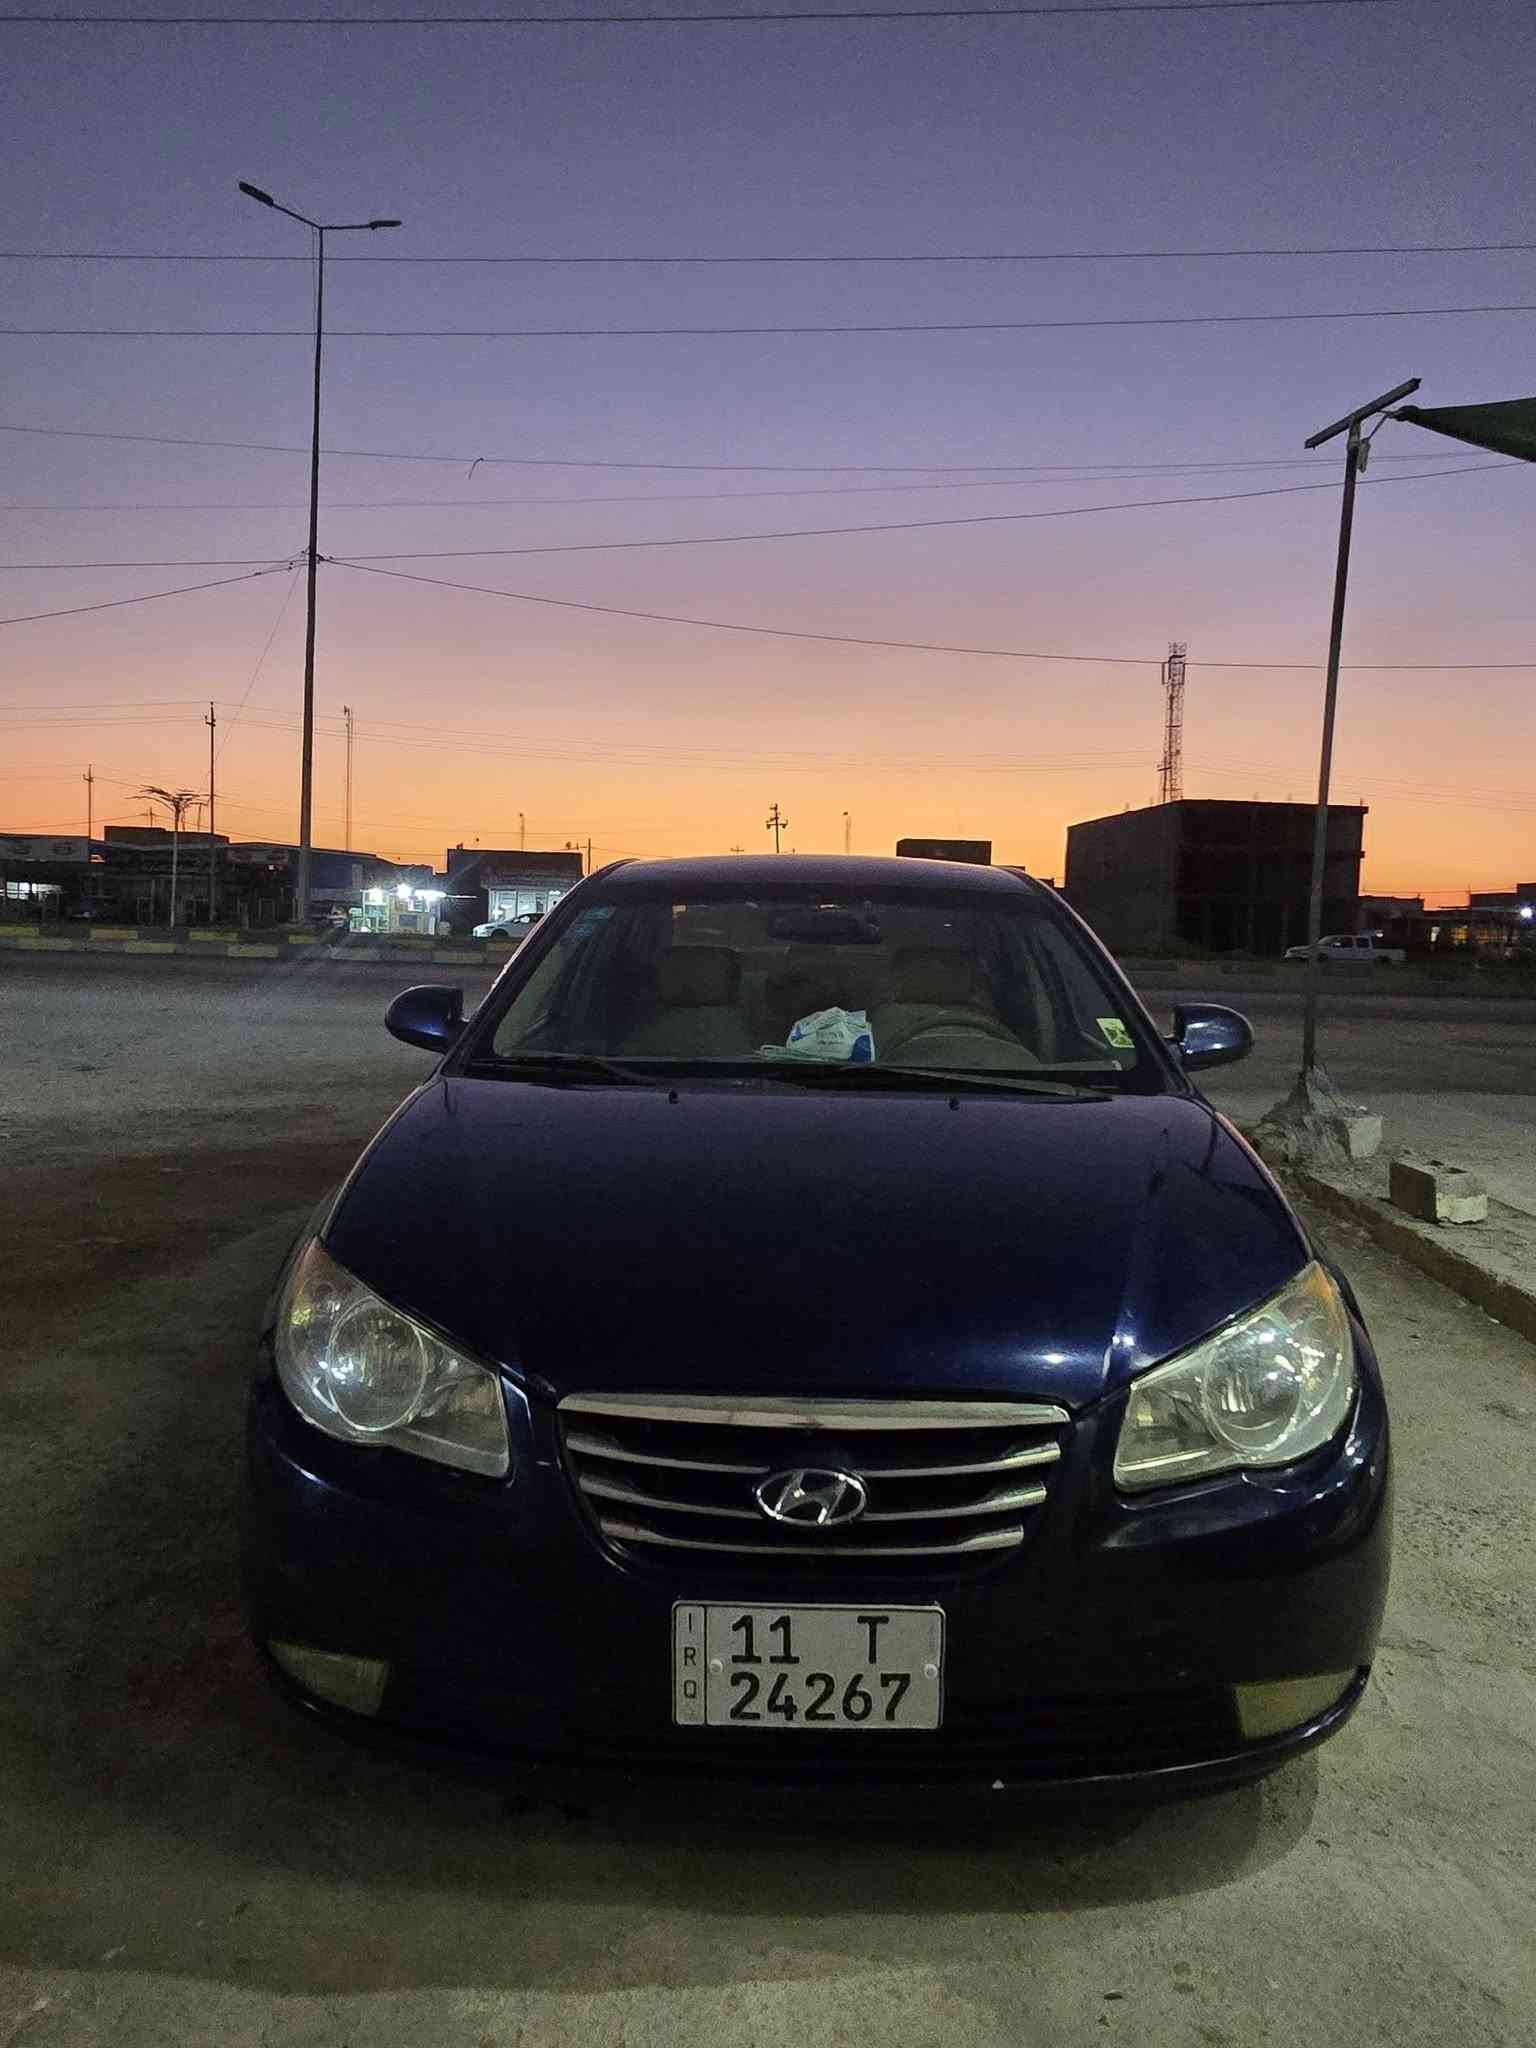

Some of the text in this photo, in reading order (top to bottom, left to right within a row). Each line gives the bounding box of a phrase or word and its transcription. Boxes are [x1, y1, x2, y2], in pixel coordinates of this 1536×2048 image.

[683, 1612, 697, 1699] IRQ
[731, 1614, 890, 1664] 11 T
[730, 1671, 912, 1721] 24267
